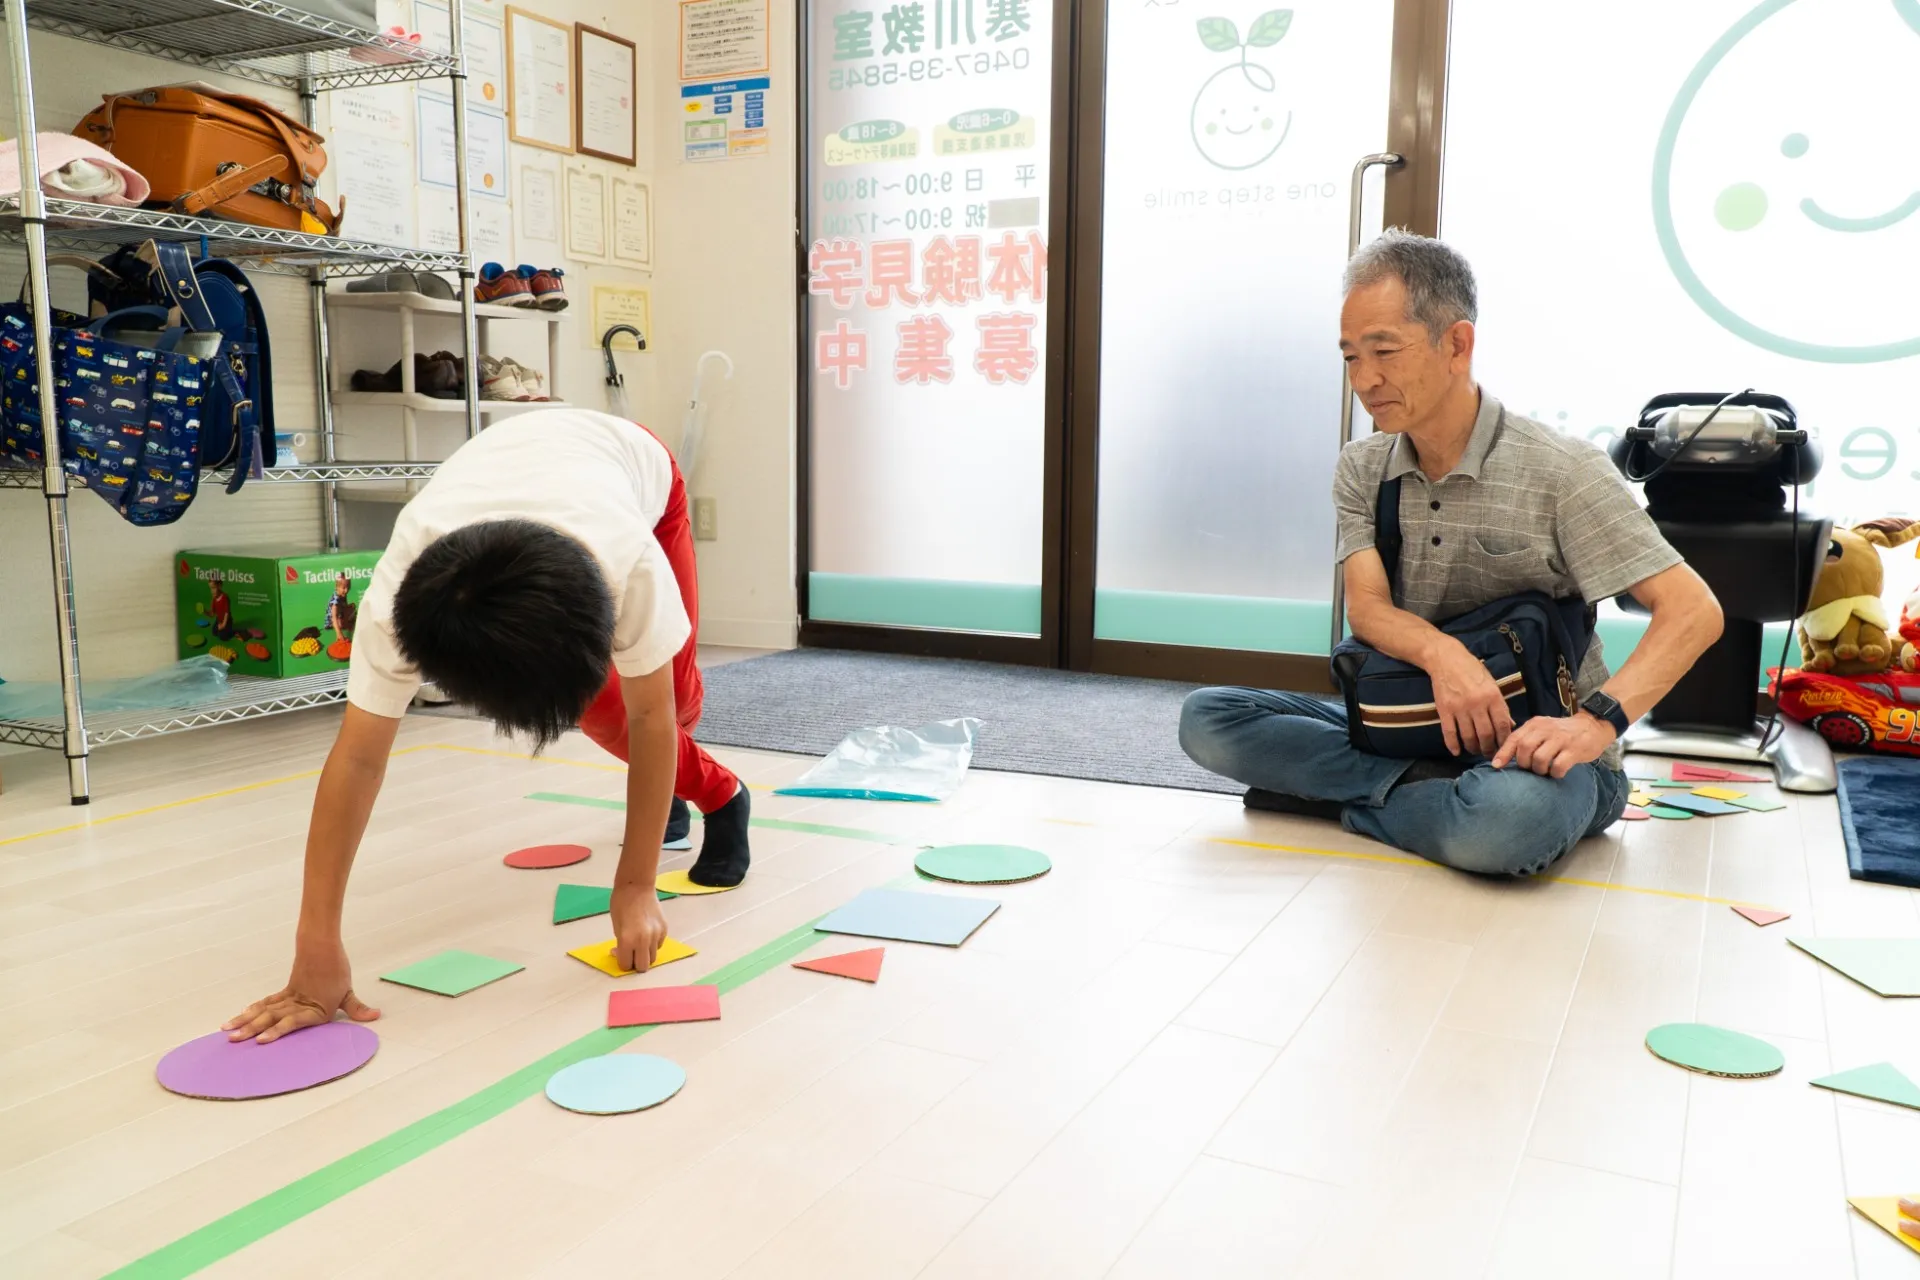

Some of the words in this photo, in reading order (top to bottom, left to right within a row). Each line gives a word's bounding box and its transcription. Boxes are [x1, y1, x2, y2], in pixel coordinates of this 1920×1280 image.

[194, 567, 226, 581] Tactile
[227, 569, 255, 584] Discs
[303, 570, 340, 584] Tactile
[344, 566, 374, 579] Discs
